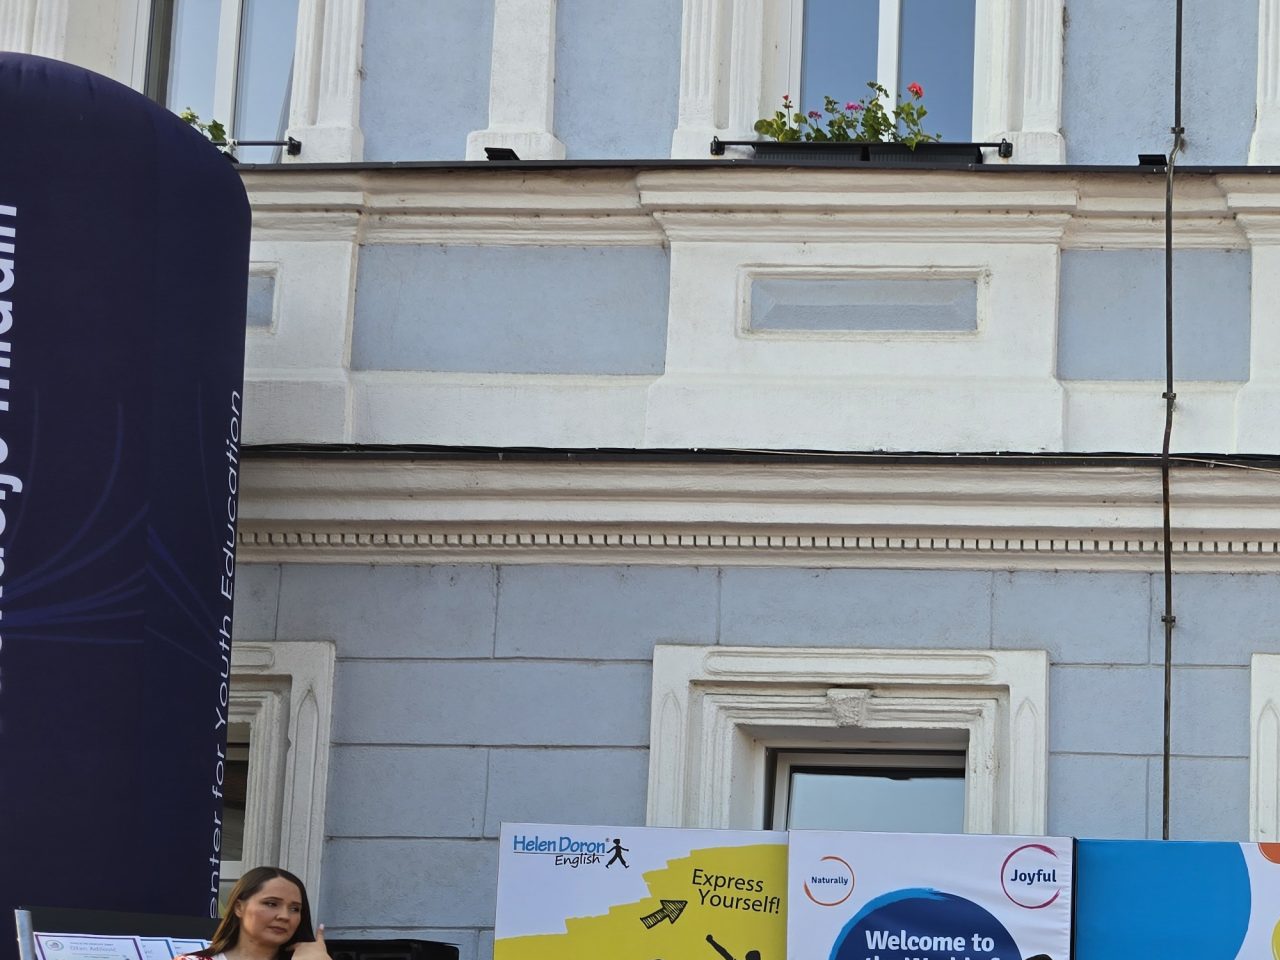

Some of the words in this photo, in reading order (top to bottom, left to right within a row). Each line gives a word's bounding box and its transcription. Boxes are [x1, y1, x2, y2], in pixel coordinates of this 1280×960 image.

[221, 391, 241, 600] Education
[215, 615, 232, 730] Youth
[211, 744, 225, 798] for
[513, 835, 556, 852] Helen
[559, 836, 605, 853] Doron
[210, 811, 222, 919] enter
[555, 853, 601, 868] English
[692, 868, 764, 892] Express
[811, 876, 849, 886] Naturally
[1010, 869, 1056, 885] Joyful
[698, 888, 780, 914] Yourself!
[865, 930, 965, 951] Welcome
[971, 933, 995, 952] to
